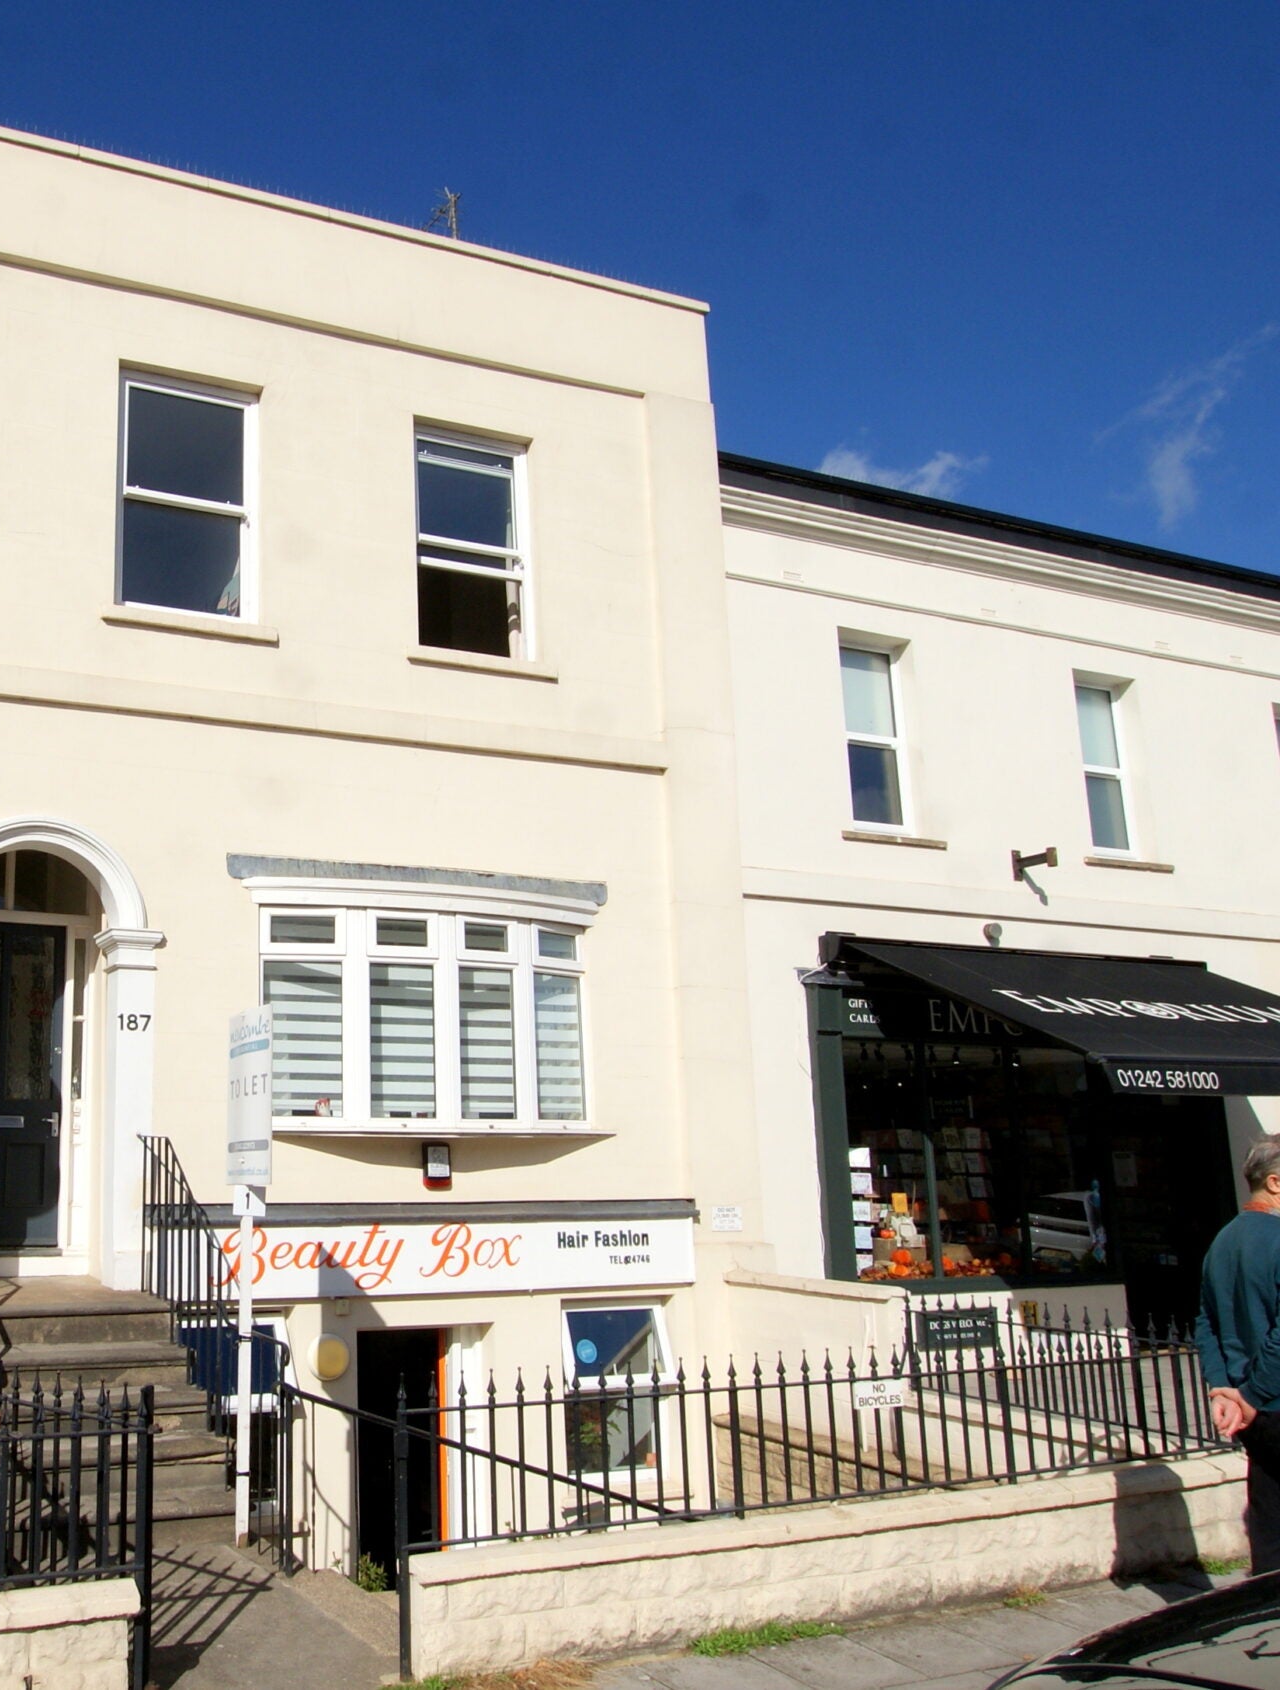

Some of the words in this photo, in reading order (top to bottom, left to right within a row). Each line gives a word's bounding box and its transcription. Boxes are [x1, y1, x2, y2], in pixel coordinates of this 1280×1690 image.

[117, 1013, 152, 1032] 187
[849, 1013, 880, 1024] CARDS
[244, 1073, 268, 1097] LET
[1117, 1069, 1164, 1088] 01242
[1166, 1070, 1220, 1090] 581000
[245, 1191, 251, 1210] 1
[557, 1231, 589, 1249] Hair
[594, 1229, 650, 1248] Fashion
[209, 1222, 405, 1291] Beauty
[419, 1221, 522, 1278] Box
[872, 1383, 886, 1394] NO
[858, 1394, 902, 1407] BICYCLES
